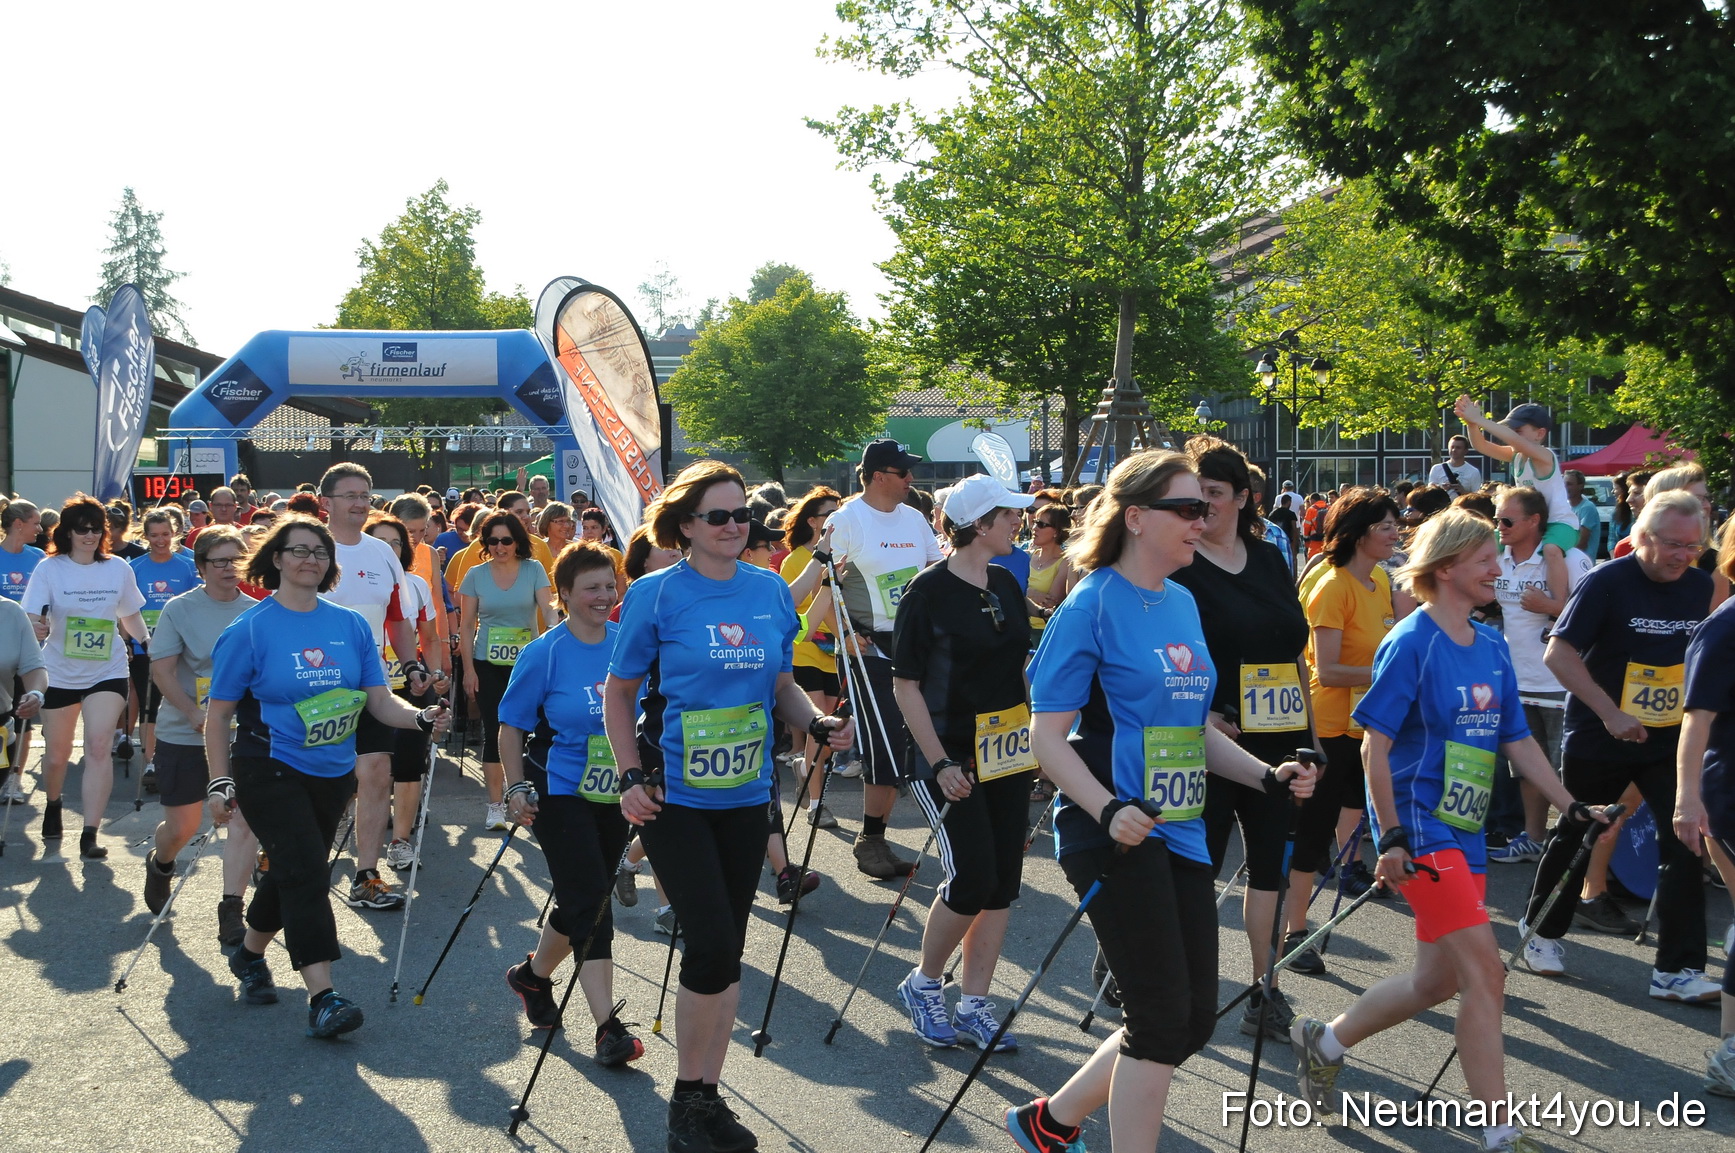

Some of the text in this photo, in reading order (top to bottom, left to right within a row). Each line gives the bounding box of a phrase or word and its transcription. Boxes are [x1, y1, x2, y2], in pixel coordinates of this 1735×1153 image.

[117, 312, 140, 431] Fischer
[370, 362, 447, 377] firmenlauf
[219, 386, 263, 397] Fischer
[2, 584, 27, 592] campin
[72, 631, 106, 650] 134
[705, 624, 720, 646] I
[291, 652, 304, 670] I
[710, 645, 765, 662] camping
[1153, 648, 1172, 673] I
[296, 667, 341, 679] camping
[743, 661, 765, 669] Berger
[1164, 672, 1210, 691] camping
[583, 686, 597, 705] I
[1243, 687, 1304, 715] 1108
[1456, 686, 1469, 711] I
[1631, 686, 1680, 712] 489
[307, 711, 360, 745] 5051
[686, 713, 712, 724] 2014
[979, 727, 1031, 764] 1103
[1149, 731, 1175, 741] 2014
[689, 739, 762, 778] 5057
[1150, 769, 1205, 808] 5056
[1443, 781, 1489, 822] 5049
